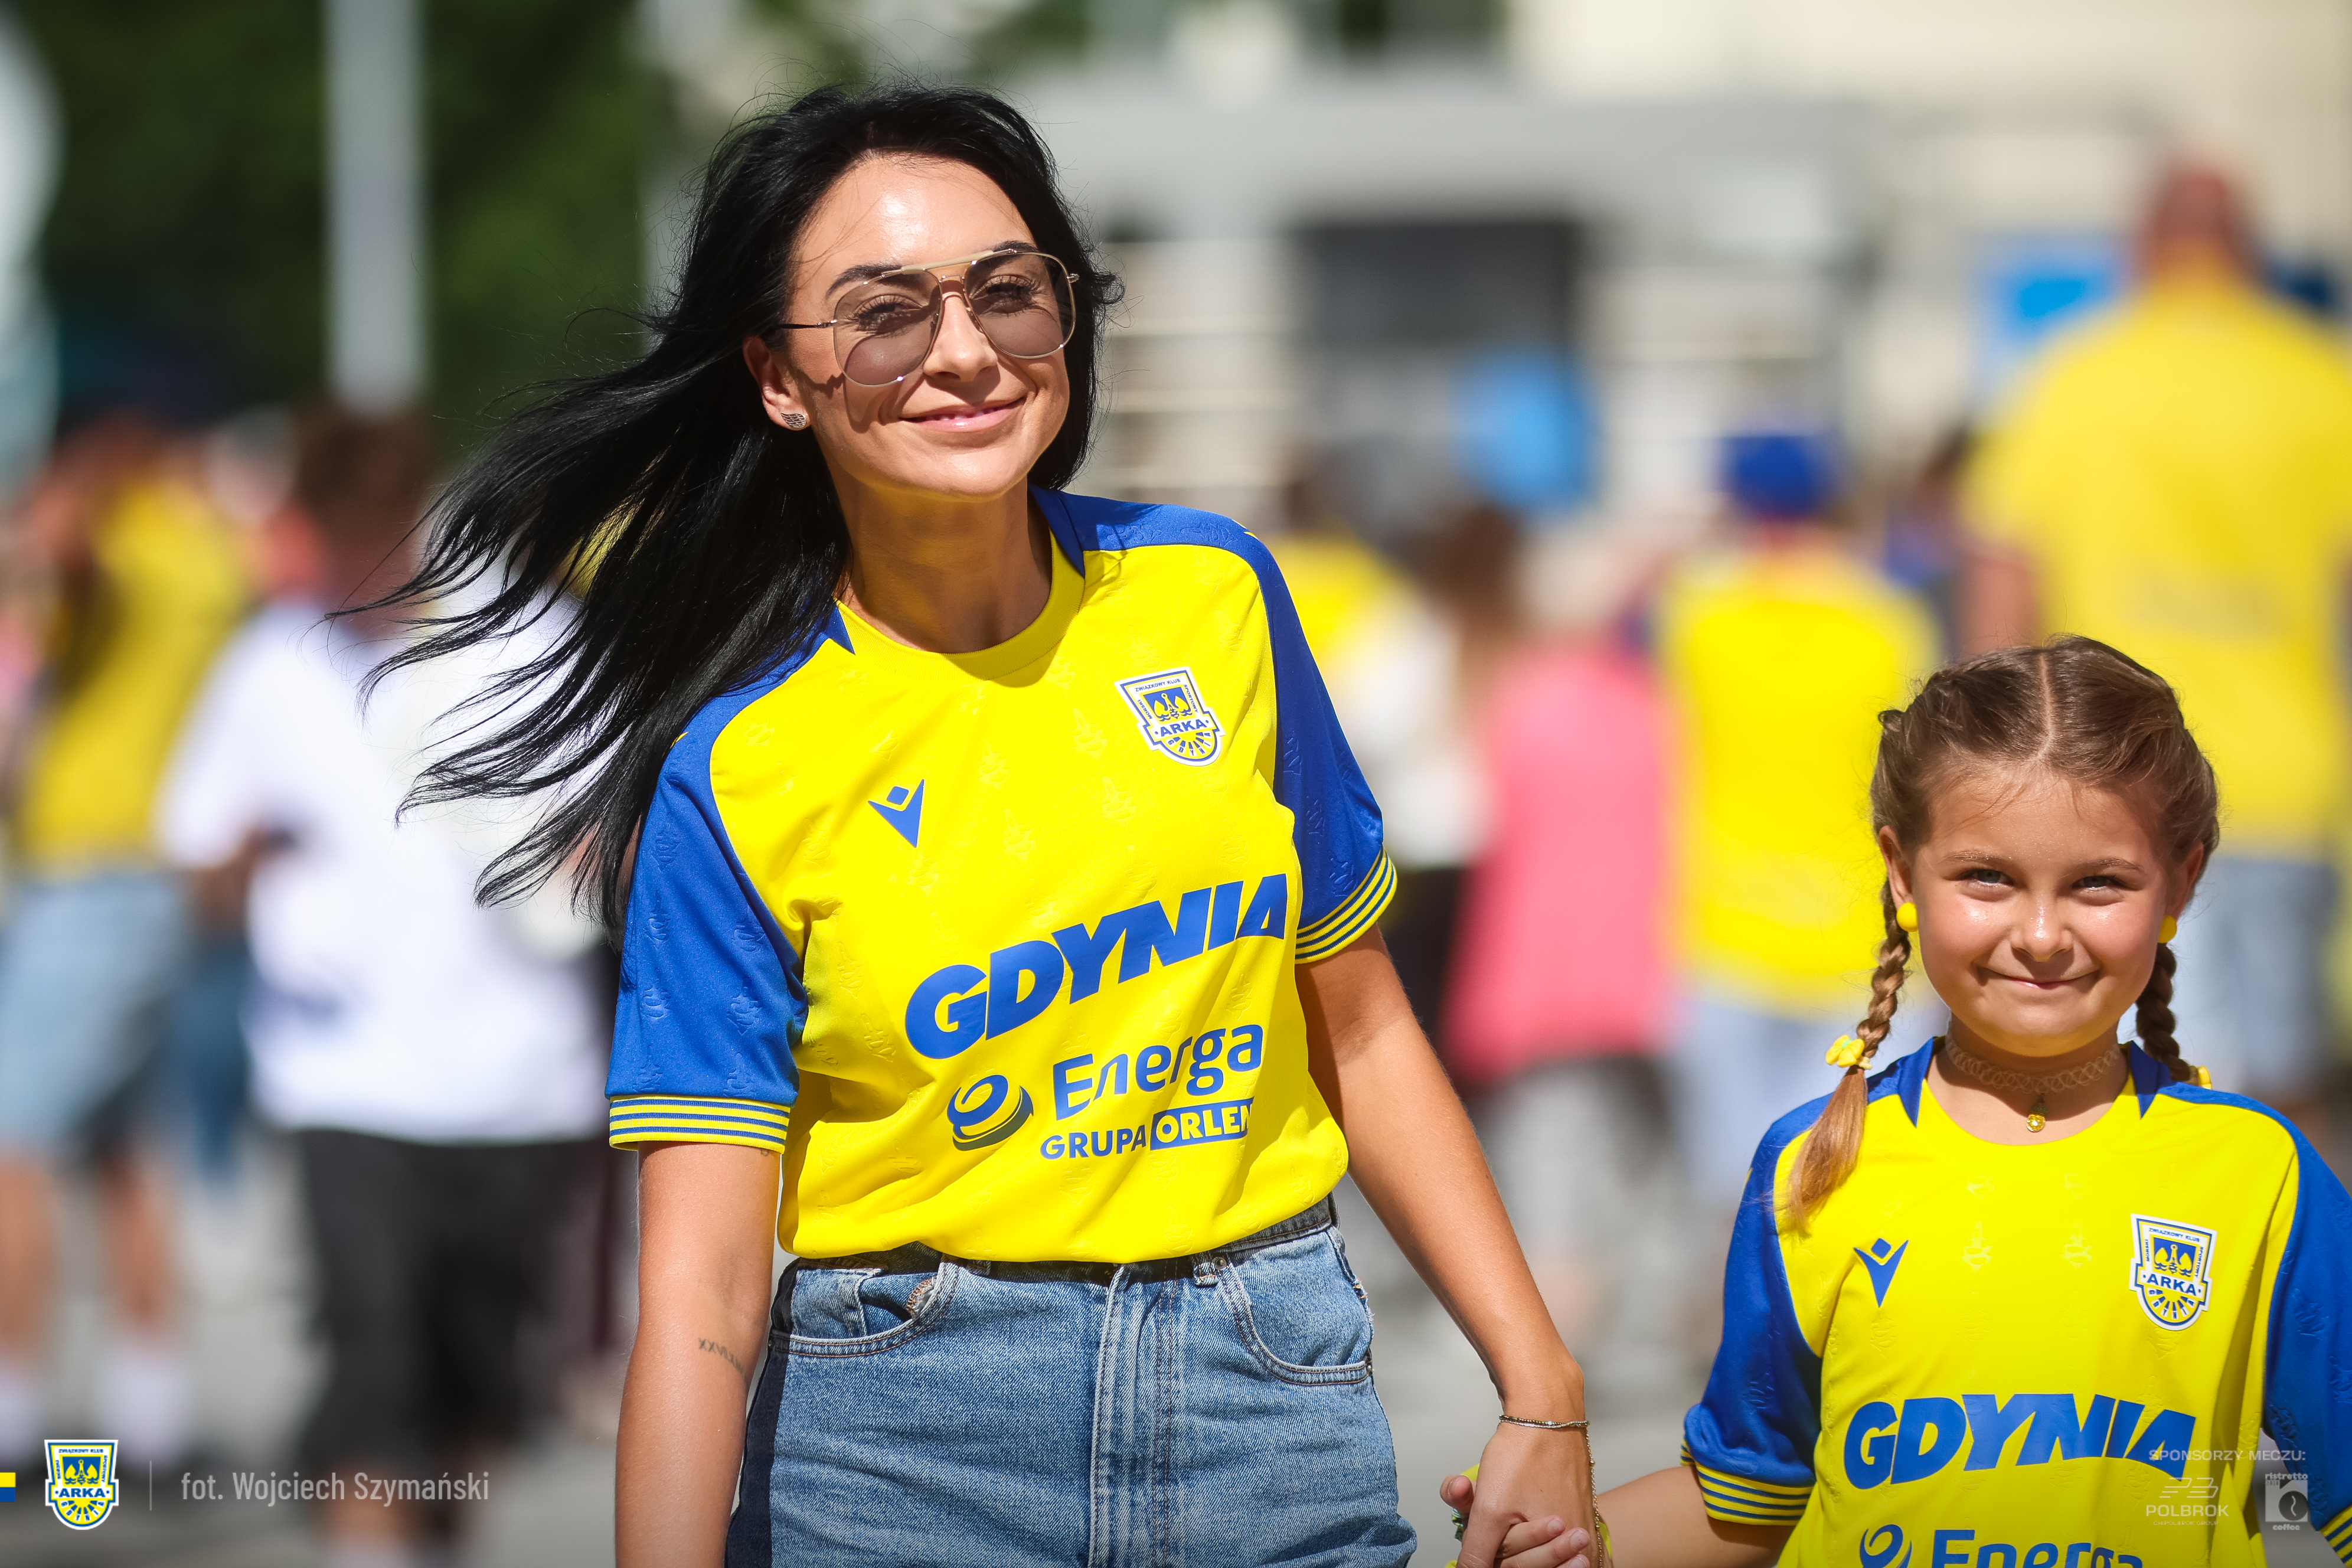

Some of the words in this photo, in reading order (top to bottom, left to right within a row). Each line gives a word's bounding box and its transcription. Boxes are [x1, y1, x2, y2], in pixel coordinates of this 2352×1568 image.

[1135, 681, 1165, 692] ZWIĄZKOWY
[1167, 678, 1181, 687] KLUB
[1183, 684, 1198, 713] SPORTOWY
[1138, 700, 1153, 720] MORSKI
[1160, 718, 1207, 737] ARKA
[904, 873, 1288, 1060] GDYNIA
[1053, 1024, 1263, 1121] Energa
[1040, 1125, 1146, 1160] GRUPA
[2149, 1227, 2183, 1239] ZWIĄZKOWY
[2195, 1246, 2204, 1278] SPORTOWY
[2147, 1273, 2197, 1296] ARKA
[1844, 1393, 2196, 1490] GDYNIA
